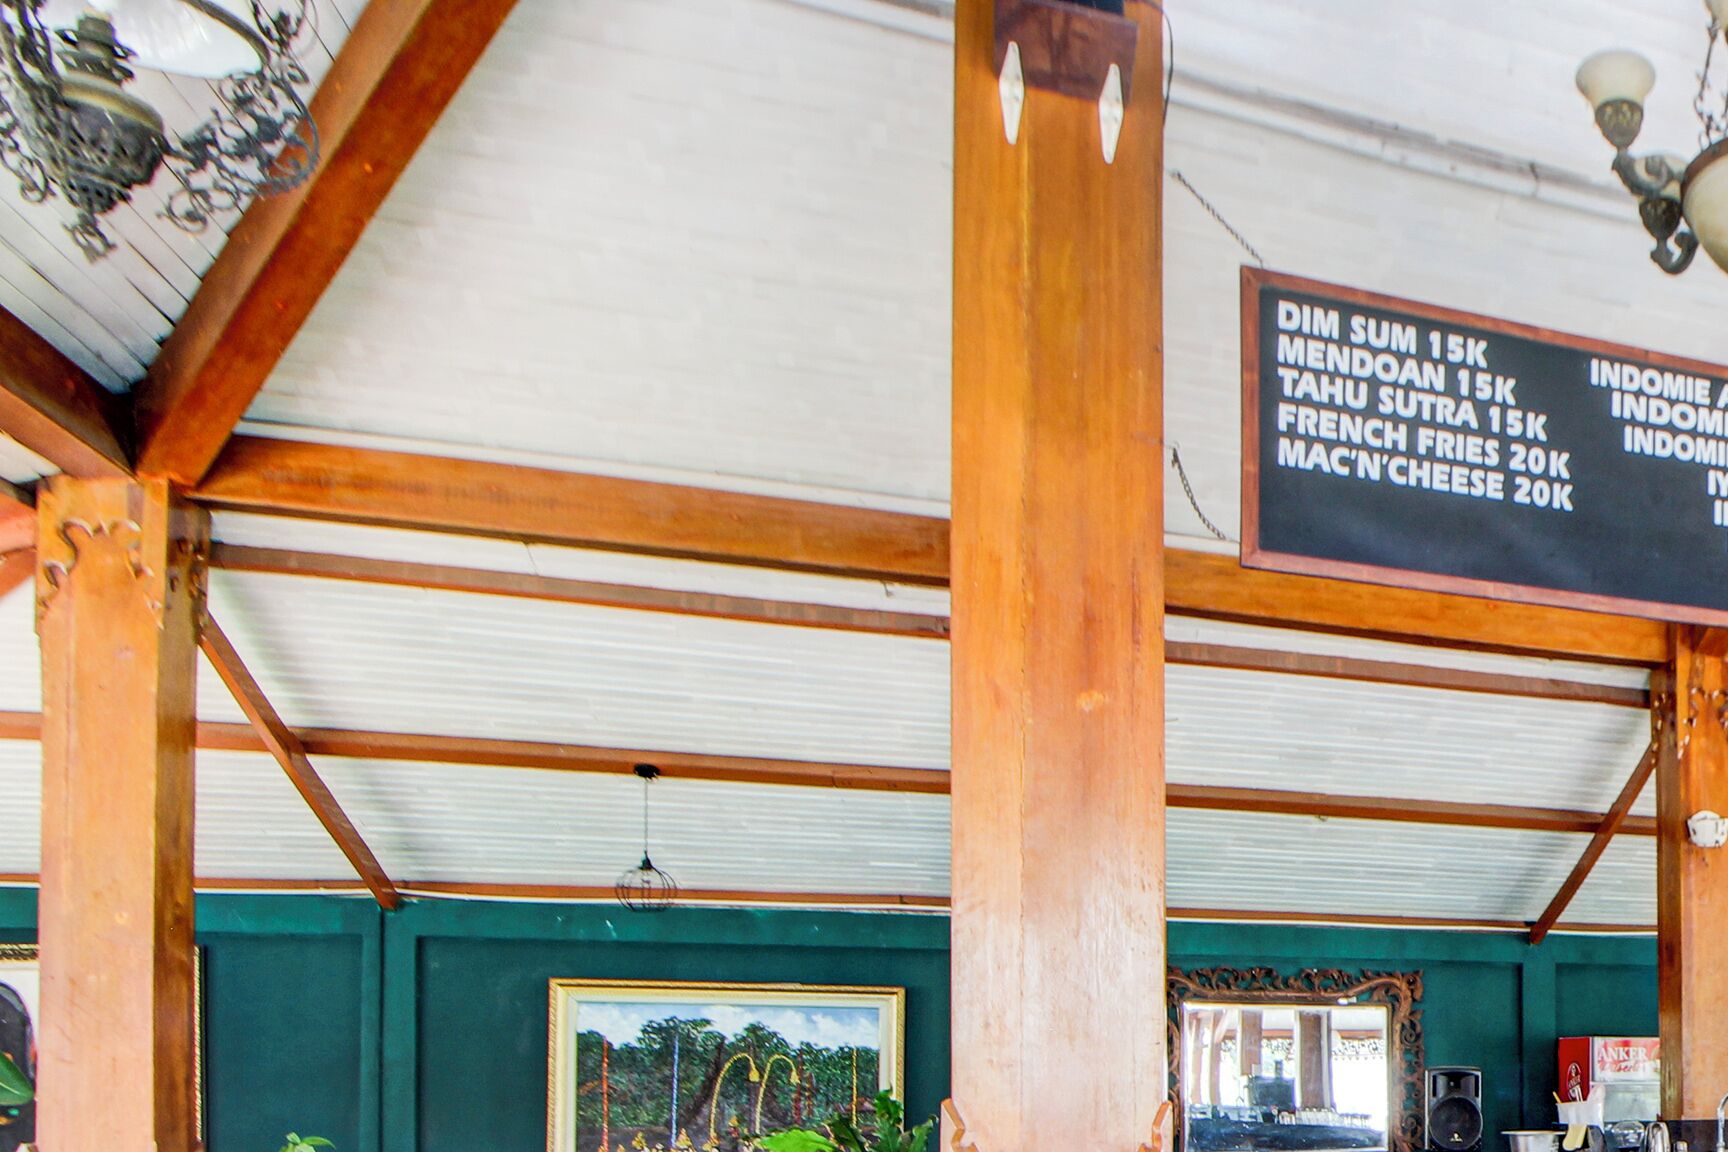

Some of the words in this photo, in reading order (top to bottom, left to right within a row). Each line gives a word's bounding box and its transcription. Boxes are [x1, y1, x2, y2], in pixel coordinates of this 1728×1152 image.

[1277, 334, 1445, 392] MENDOAN
[1458, 369, 1516, 406] 15K
[1278, 300, 1339, 340] DIM
[1350, 315, 1417, 354] SUM
[1429, 331, 1487, 368] 15K
[1278, 366, 1368, 409] TAHU
[1378, 385, 1478, 429] SUTRA
[1489, 406, 1547, 441] 15K
[1590, 358, 1711, 406] INDOMIE
[1278, 402, 1407, 451] FRENCH
[1417, 427, 1499, 466] FRIES
[1509, 443, 1570, 479] 20K
[1278, 437, 1504, 500] MAC'N'CHEESE
[1514, 476, 1573, 511] 20K
[1597, 1047, 1649, 1061] ANKER
